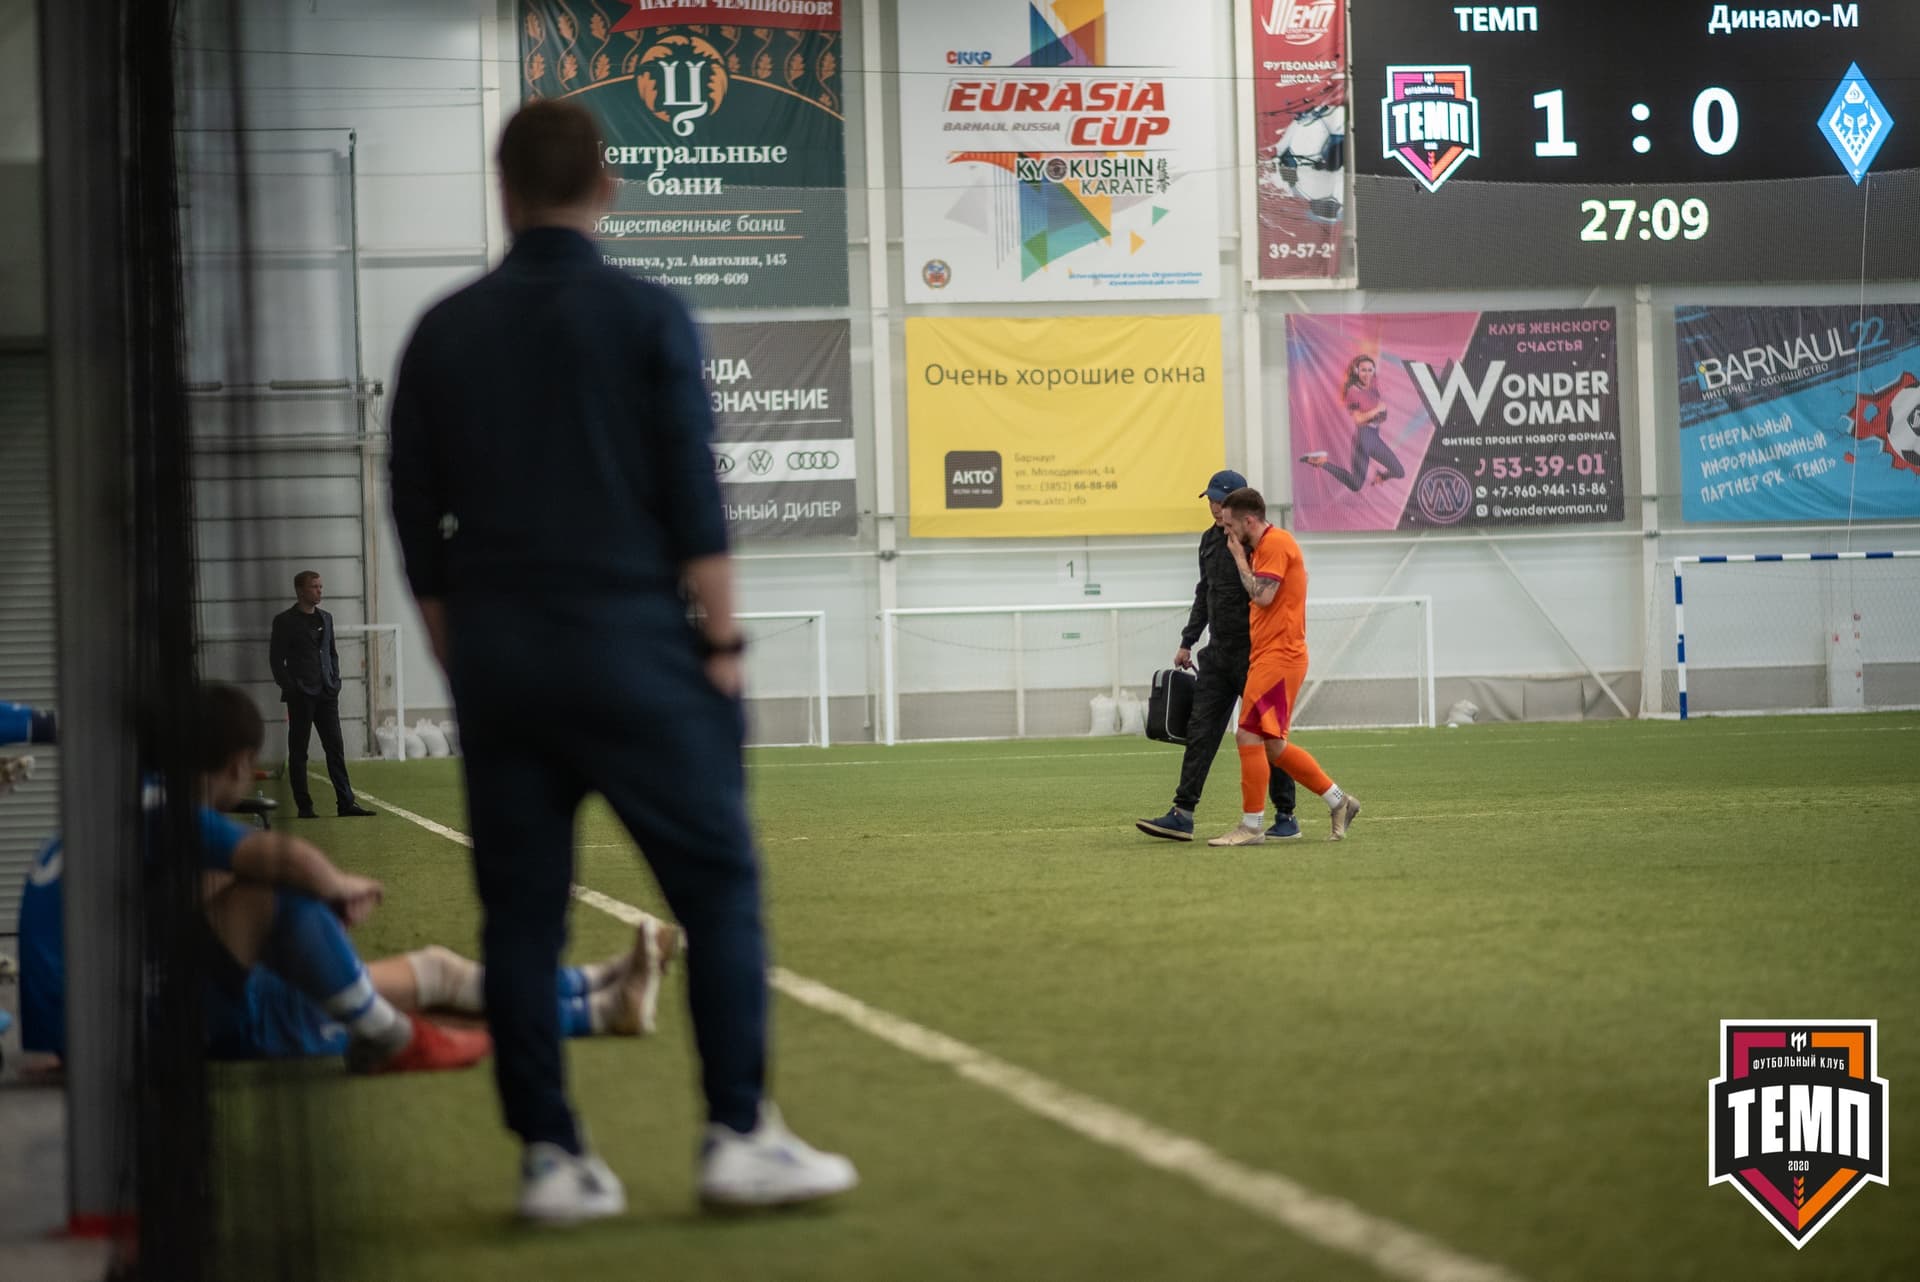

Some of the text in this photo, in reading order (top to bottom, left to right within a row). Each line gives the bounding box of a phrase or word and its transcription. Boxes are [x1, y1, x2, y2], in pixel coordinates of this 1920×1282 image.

[712, 0, 833, 15] ЧЕМПИОНОВ!
[1453, 6, 1538, 32] ТЕМП
[1708, 4, 1859, 35] Динамо-М
[1280, 73, 1321, 84] ШКОЛА
[946, 82, 1166, 113] EURASIA
[943, 121, 1060, 132] BARNAUL RUSSIA
[1070, 117, 1170, 146] CUP
[1391, 101, 1470, 144] ТЕМП
[1533, 89, 1578, 157] 1
[1692, 87, 1740, 156] 0
[598, 142, 788, 172] ентральные
[1016, 157, 1153, 180] KYOKUSHIN
[647, 170, 723, 196] бани
[1081, 178, 1154, 195] KARATE
[737, 214, 786, 232] бани
[1579, 198, 1710, 241] 27:09
[666, 255, 687, 269] ул.
[690, 254, 763, 269] Анатолия,
[694, 272, 749, 286] 999-609
[1488, 320, 1610, 335] КЛУБ ЖЕНСКОГО
[1517, 339, 1583, 352] СЧАСТЬЯ
[924, 363, 1206, 390] Очень хорошие окна
[711, 388, 829, 413] ЗНАЧЕНИЕ
[1442, 432, 1616, 446] ФИТНЕС ПРОЕКТ НОВОГО ФОРМАТА
[1700, 412, 1793, 451] ГЕНЕРАЛЬНЫЙ
[1492, 453, 1606, 479] 53-39-01
[1701, 430, 1827, 479] ИНФОРМАЦИОННЫЙ
[952, 471, 995, 485] АКТО
[1701, 474, 1759, 504] ПАРТНЕР
[1762, 469, 1785, 488] ФК
[1491, 482, 1607, 498] +7-960-944-15-86
[782, 501, 842, 521] ДИЛЕР
[1492, 504, 1608, 518] @wonderwoman.ru
[1066, 559, 1074, 579] 1
